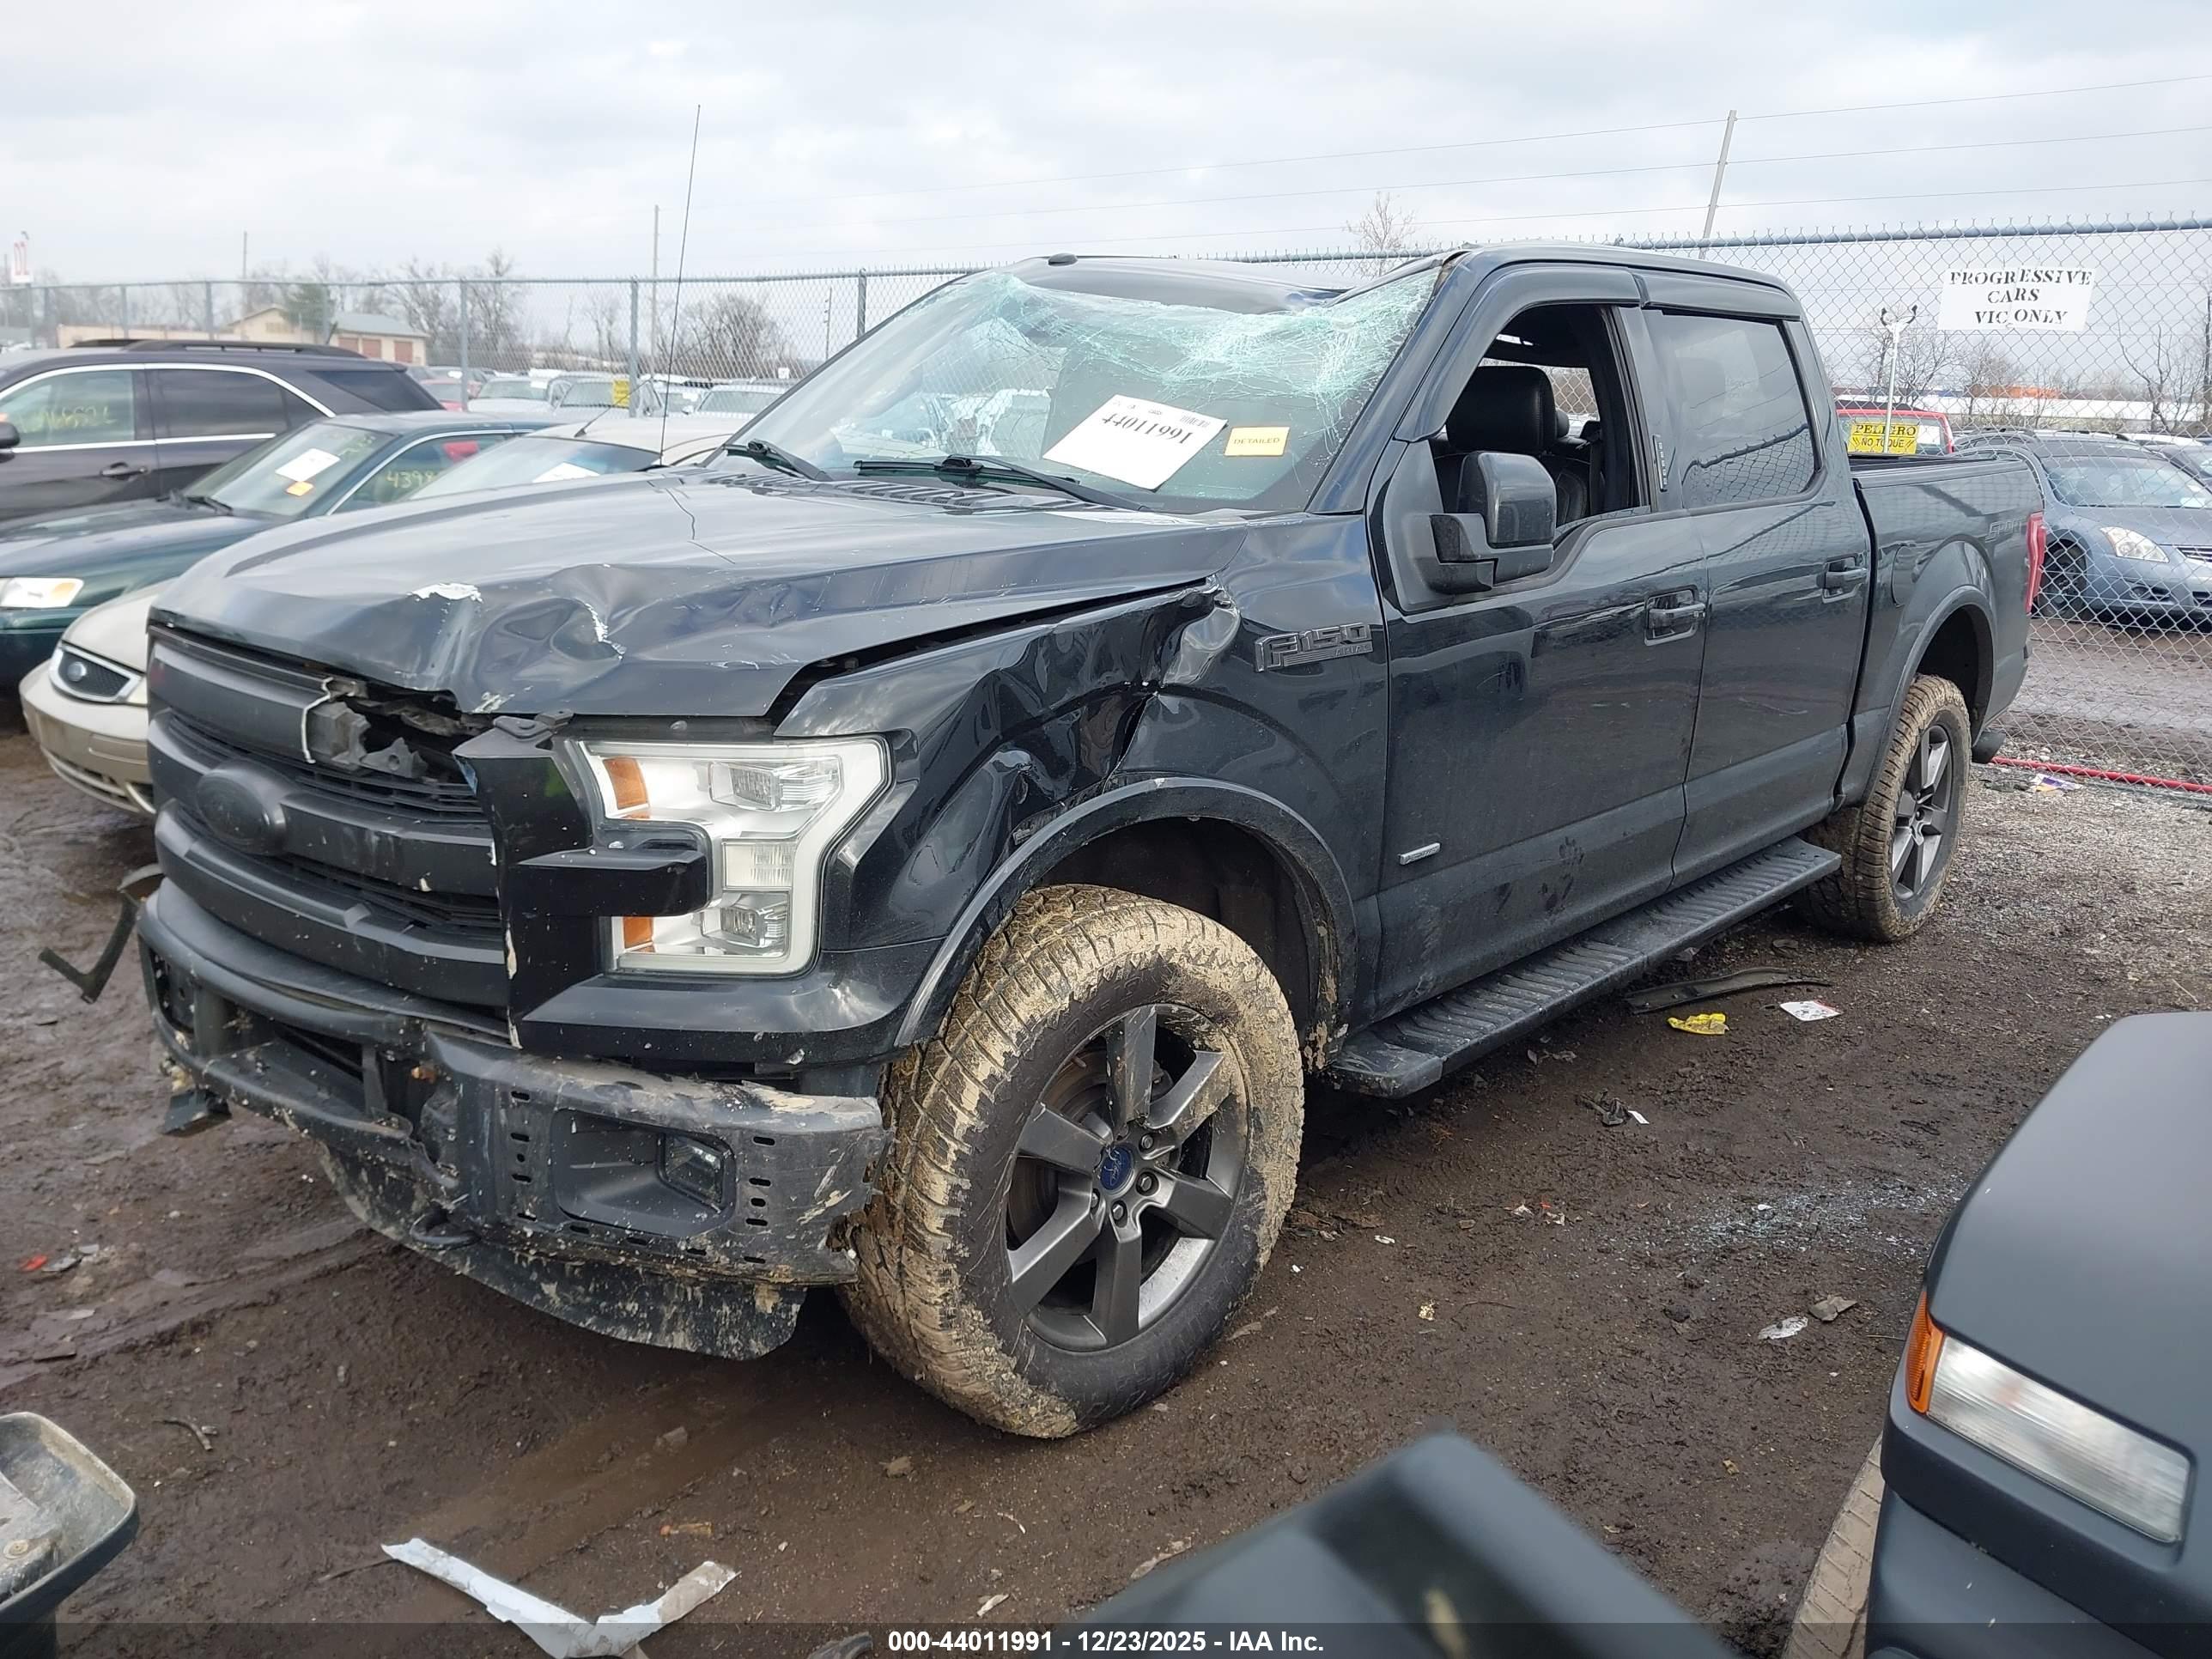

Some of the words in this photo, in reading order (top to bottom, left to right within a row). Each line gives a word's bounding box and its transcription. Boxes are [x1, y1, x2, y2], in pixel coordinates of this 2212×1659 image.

[1950, 269, 2093, 285] PROGRESSIVE
[1988, 288, 2039, 303] CARS
[1975, 311, 2008, 324] VIC
[2014, 309, 2069, 324] ONLY
[1102, 413, 1194, 444] 44011991
[1861, 437, 1874, 447] NO
